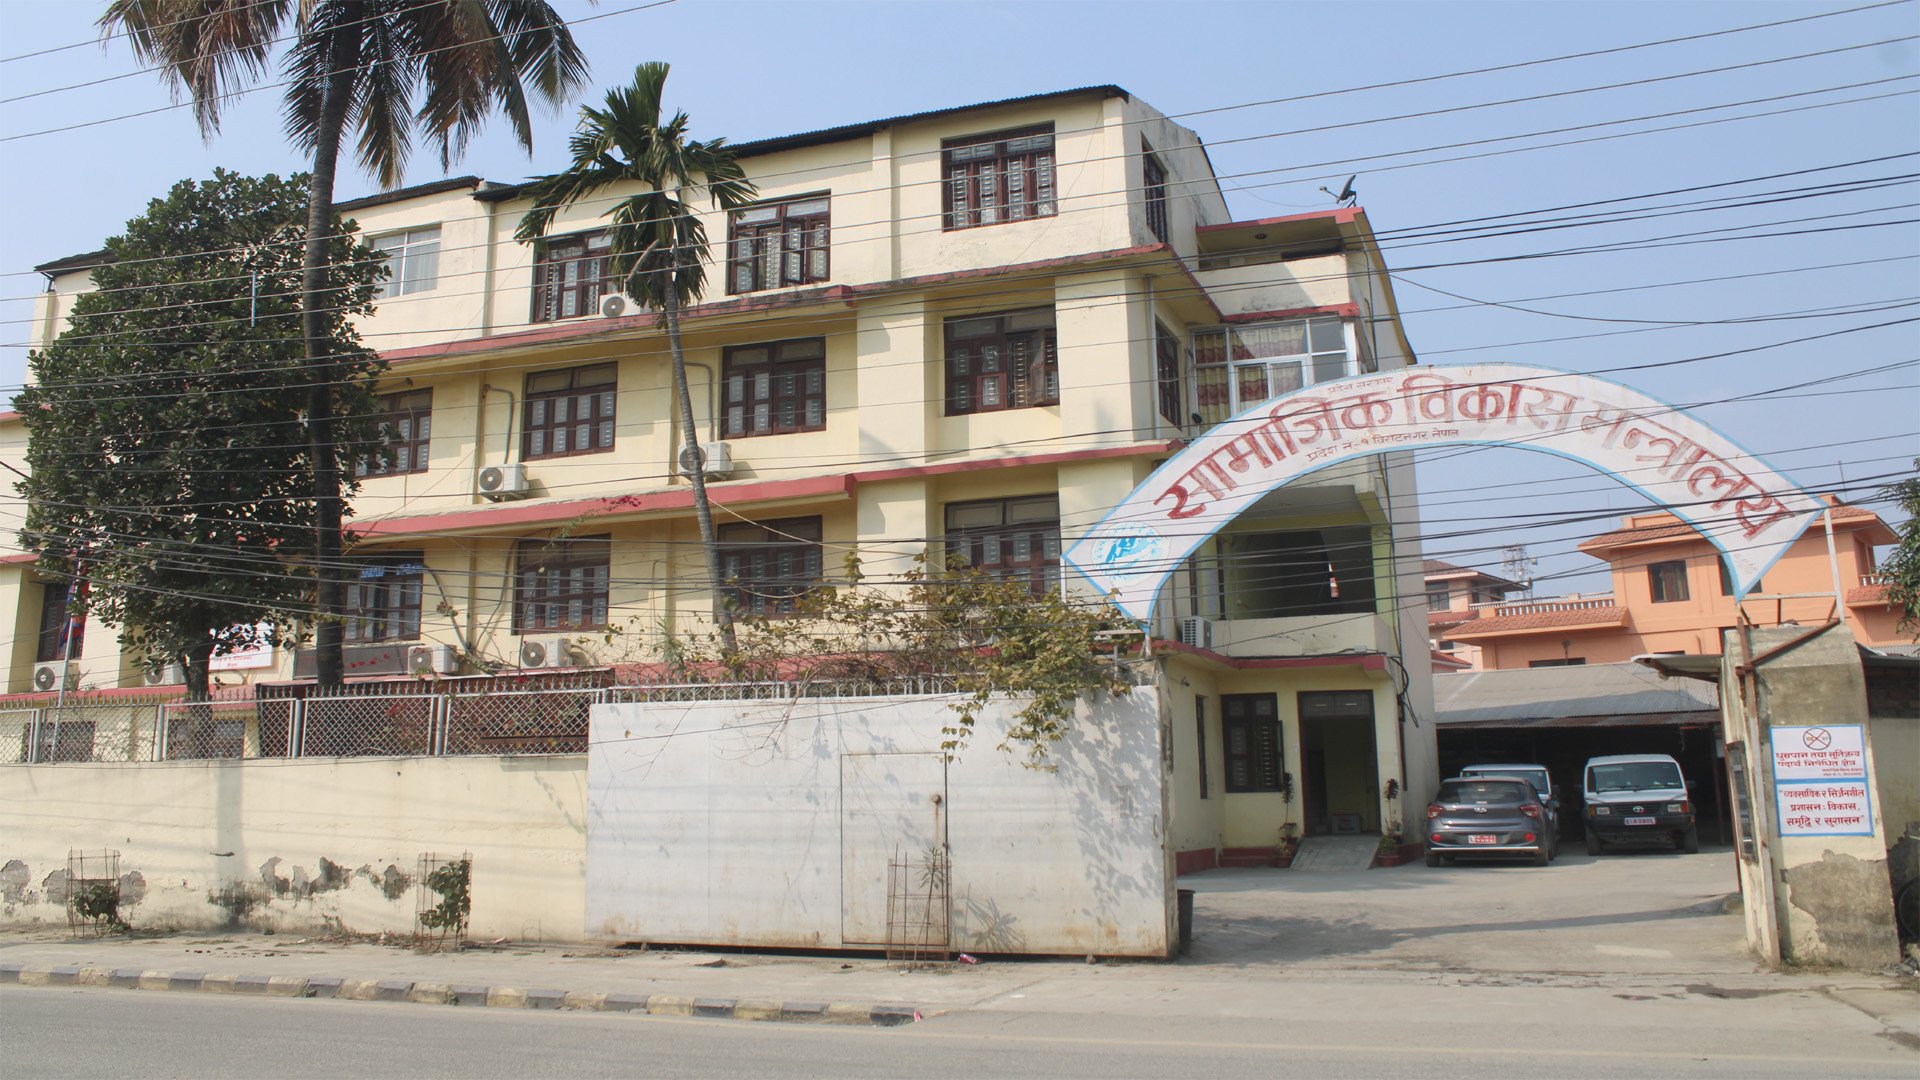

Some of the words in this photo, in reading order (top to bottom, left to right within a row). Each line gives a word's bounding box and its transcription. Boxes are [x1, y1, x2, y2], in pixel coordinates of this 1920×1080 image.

[1153, 391, 1394, 520] सामाजिक
[1397, 374, 1584, 431] विकास
[1581, 400, 1796, 540] मन्त्रालय
